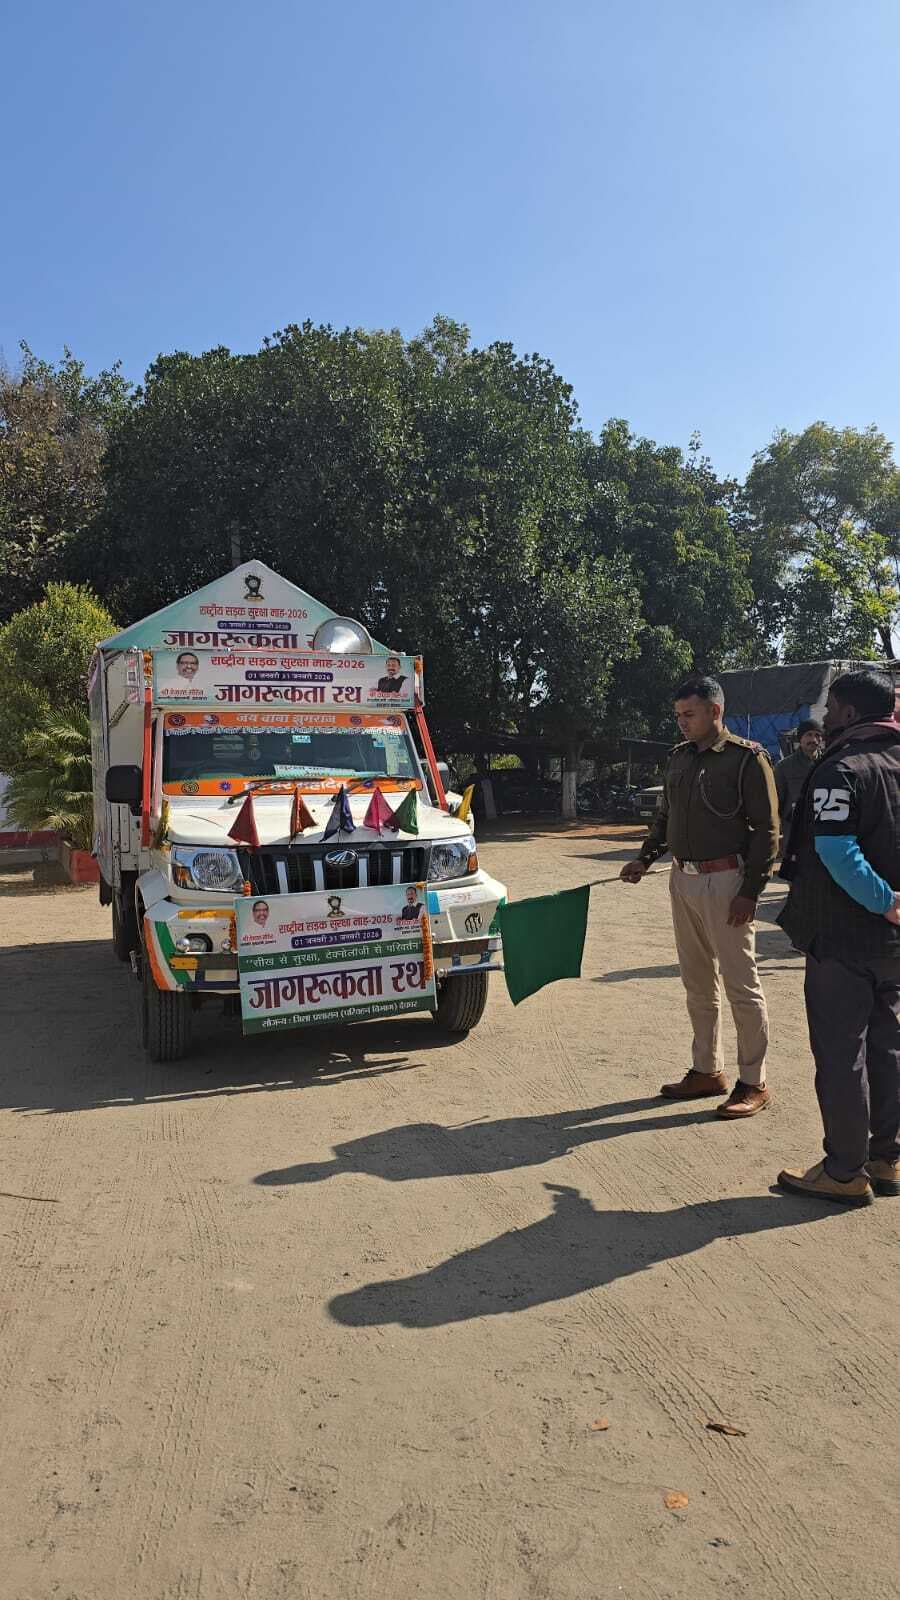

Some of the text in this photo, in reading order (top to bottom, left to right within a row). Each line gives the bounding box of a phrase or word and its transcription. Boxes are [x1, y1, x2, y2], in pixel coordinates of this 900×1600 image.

[200, 603, 224, 618] राष्ट्रीय
[162, 630, 298, 649] जागरूकता
[211, 655, 245, 668] राष्ट्रीय
[281, 657, 309, 669] सुरक्षा
[313, 658, 365, 669] माह-2026
[214, 684, 326, 703] जागरूकता
[332, 686, 362, 703] रथ
[279, 920, 304, 935] राष्ट्रीय
[248, 960, 426, 1009] जागरूकता रथ
